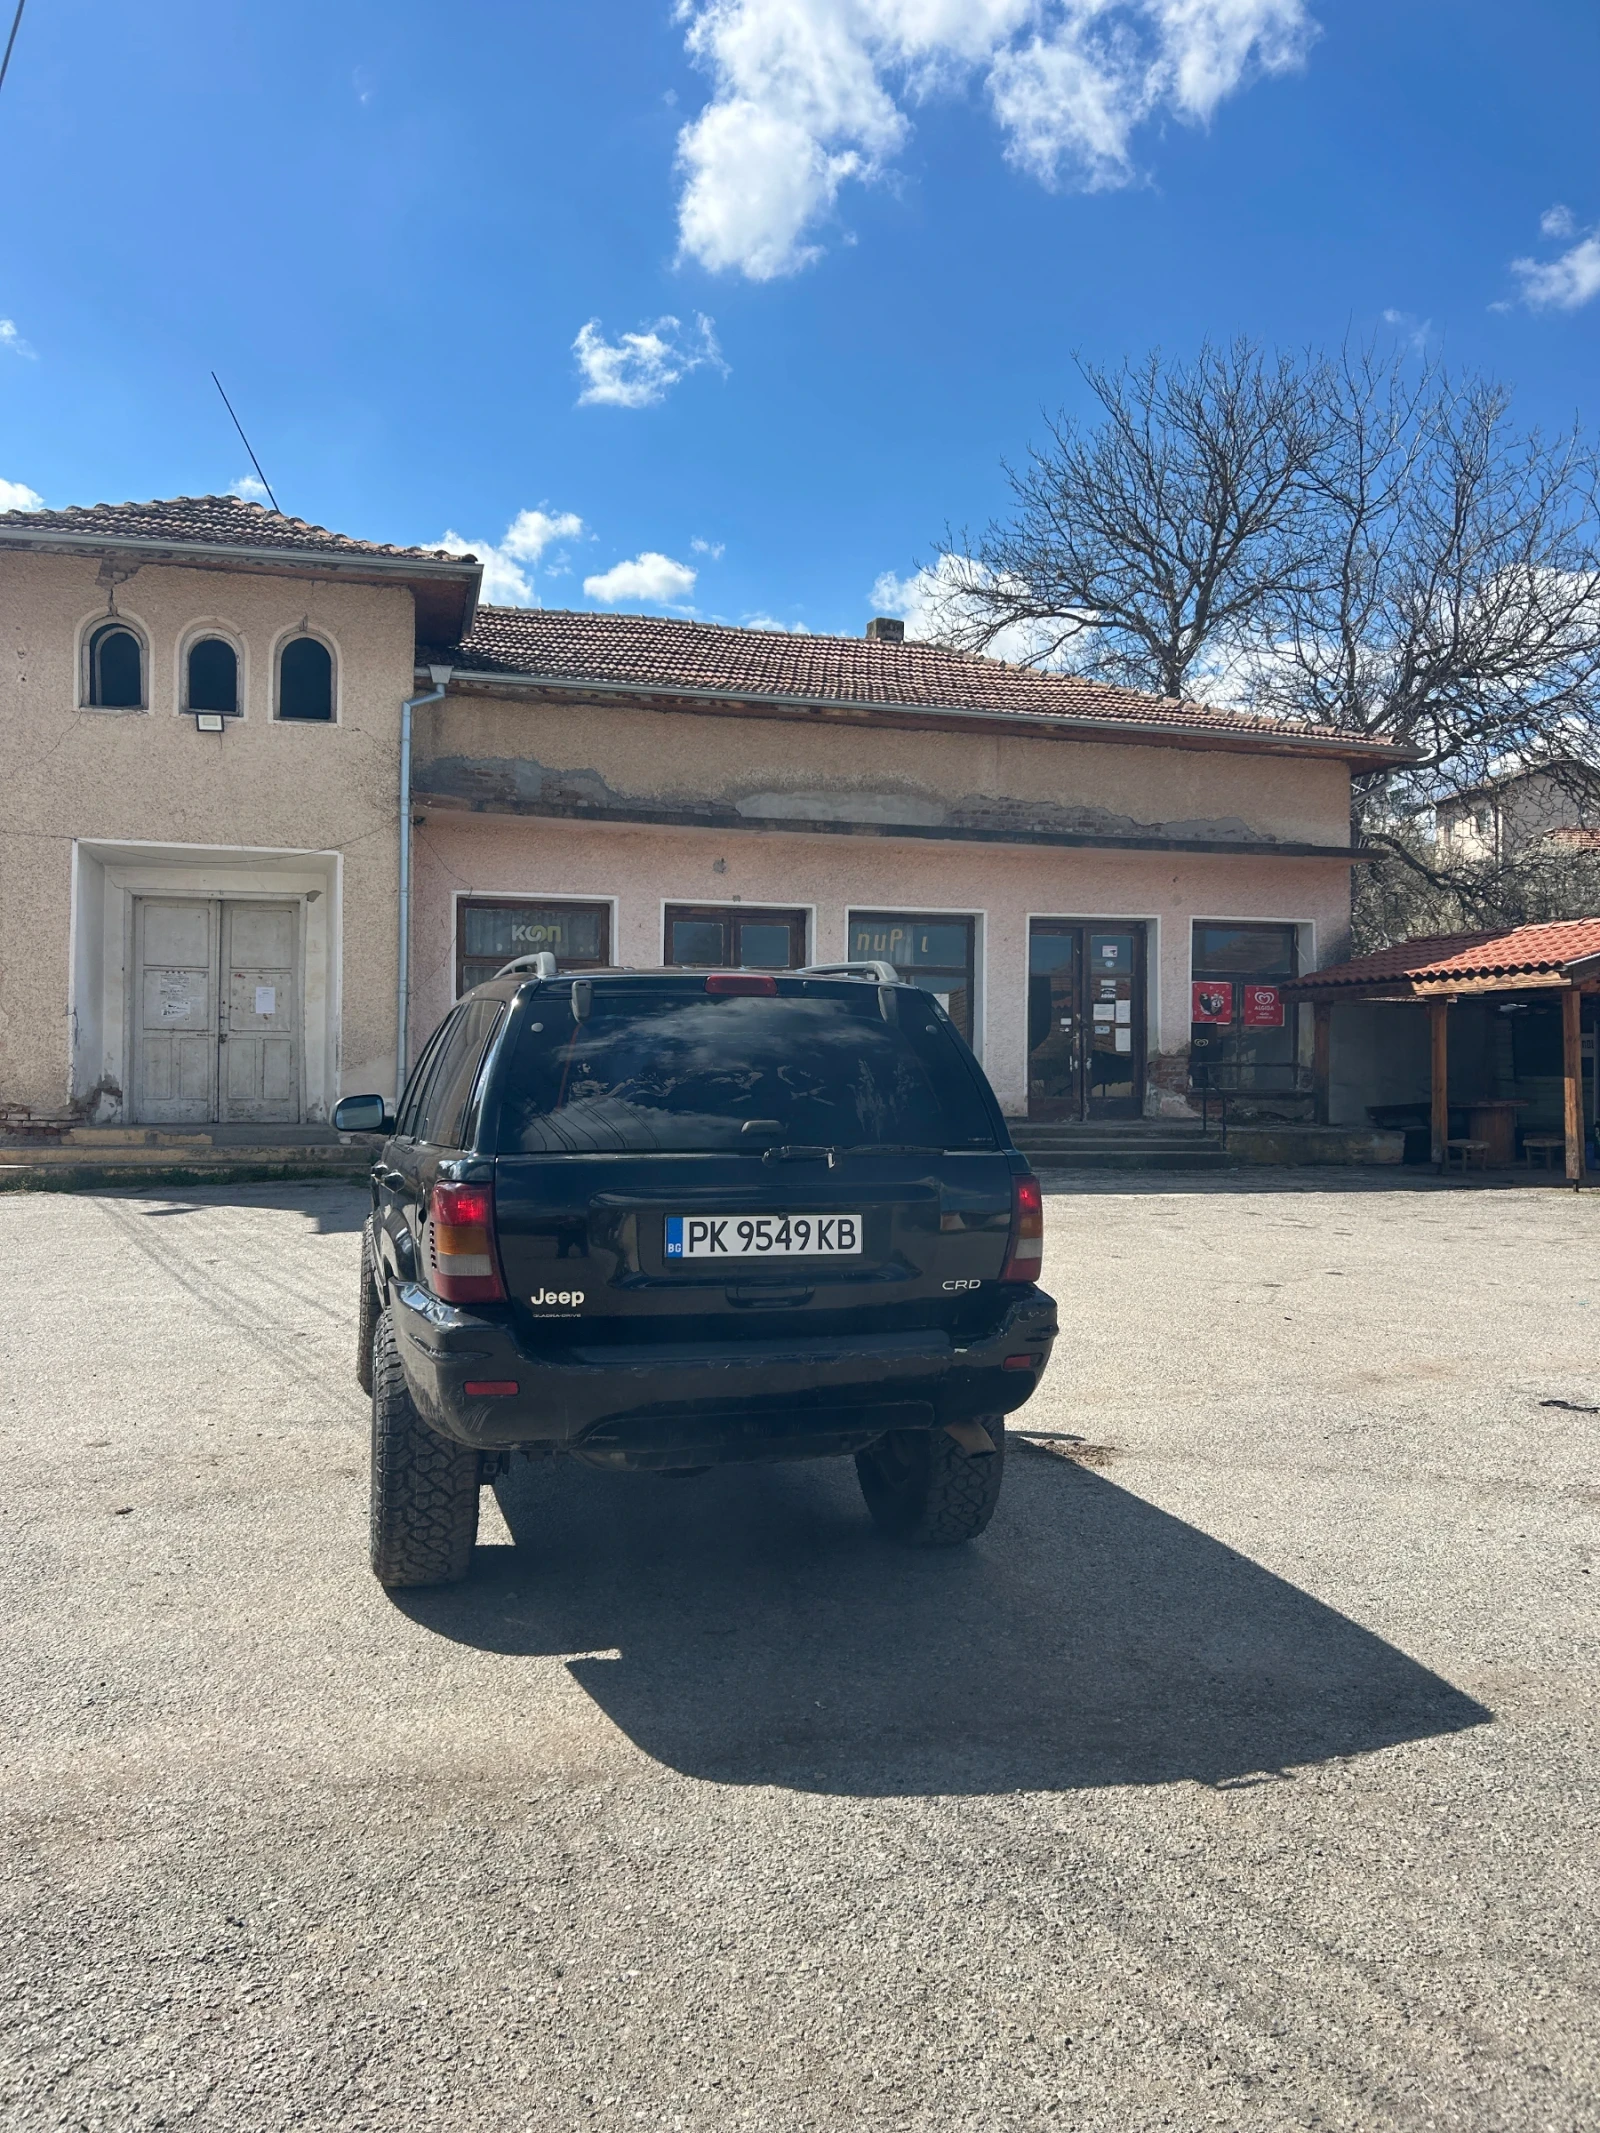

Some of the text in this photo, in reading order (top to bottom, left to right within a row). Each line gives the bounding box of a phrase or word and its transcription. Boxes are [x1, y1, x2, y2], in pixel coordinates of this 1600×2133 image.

[688, 1218, 856, 1253] PK 9549 KB
[668, 1243, 682, 1253] BG
[942, 1279, 982, 1291] CRD
[530, 1287, 585, 1307] Jeep
